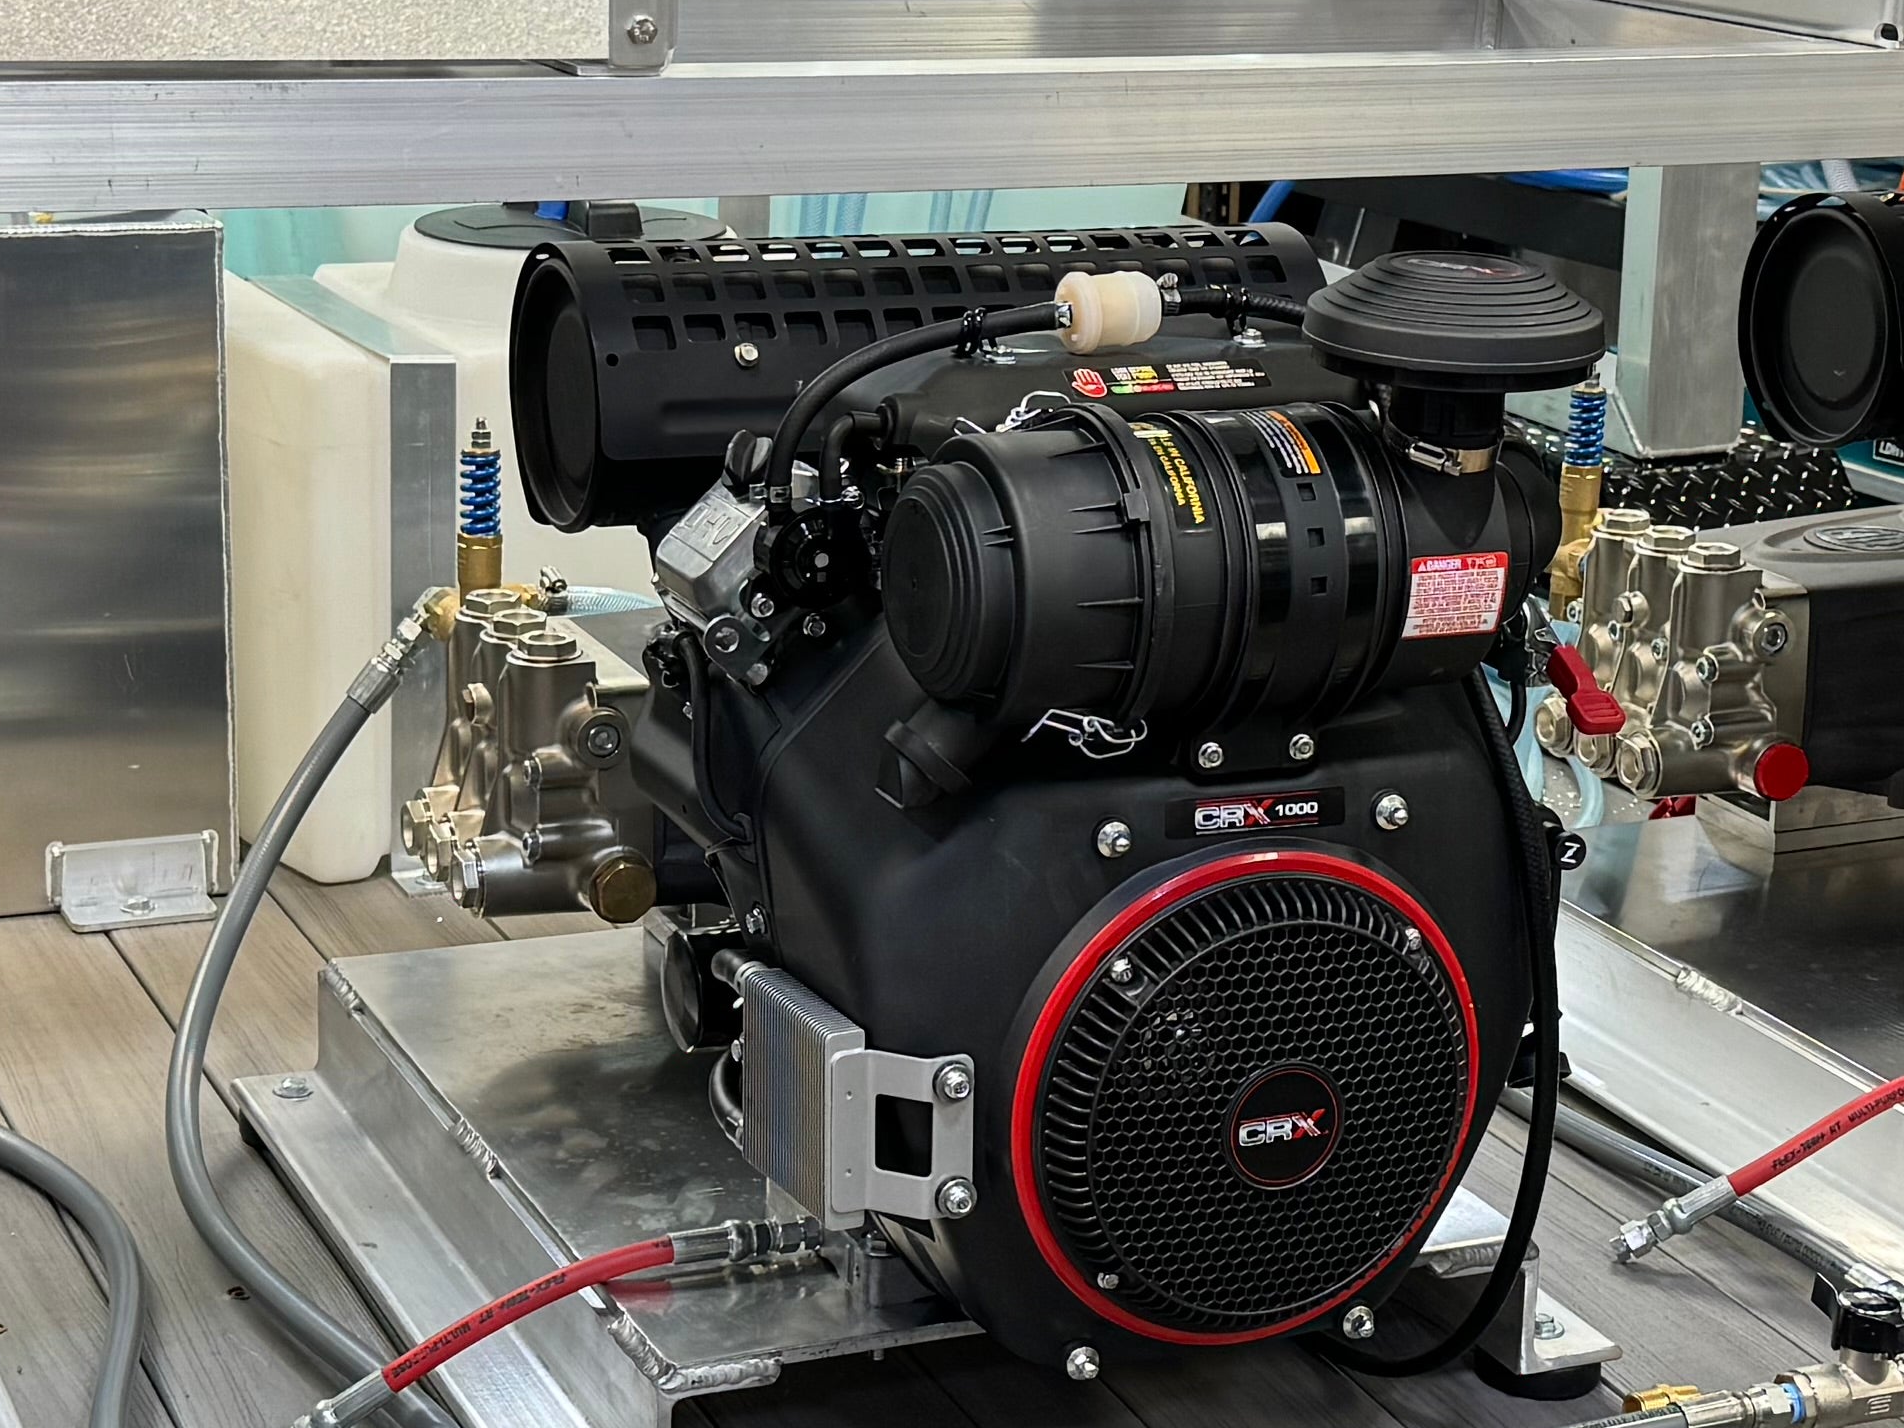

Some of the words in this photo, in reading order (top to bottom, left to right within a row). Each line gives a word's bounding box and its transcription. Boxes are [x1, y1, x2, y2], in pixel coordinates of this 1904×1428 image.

[1156, 456, 1187, 506] CALIFORNIA
[1172, 458, 1206, 524] CALIFORNIA
[1194, 798, 1275, 830] CRX
[1275, 801, 1319, 817] 1000
[1239, 1108, 1326, 1147] CRX
